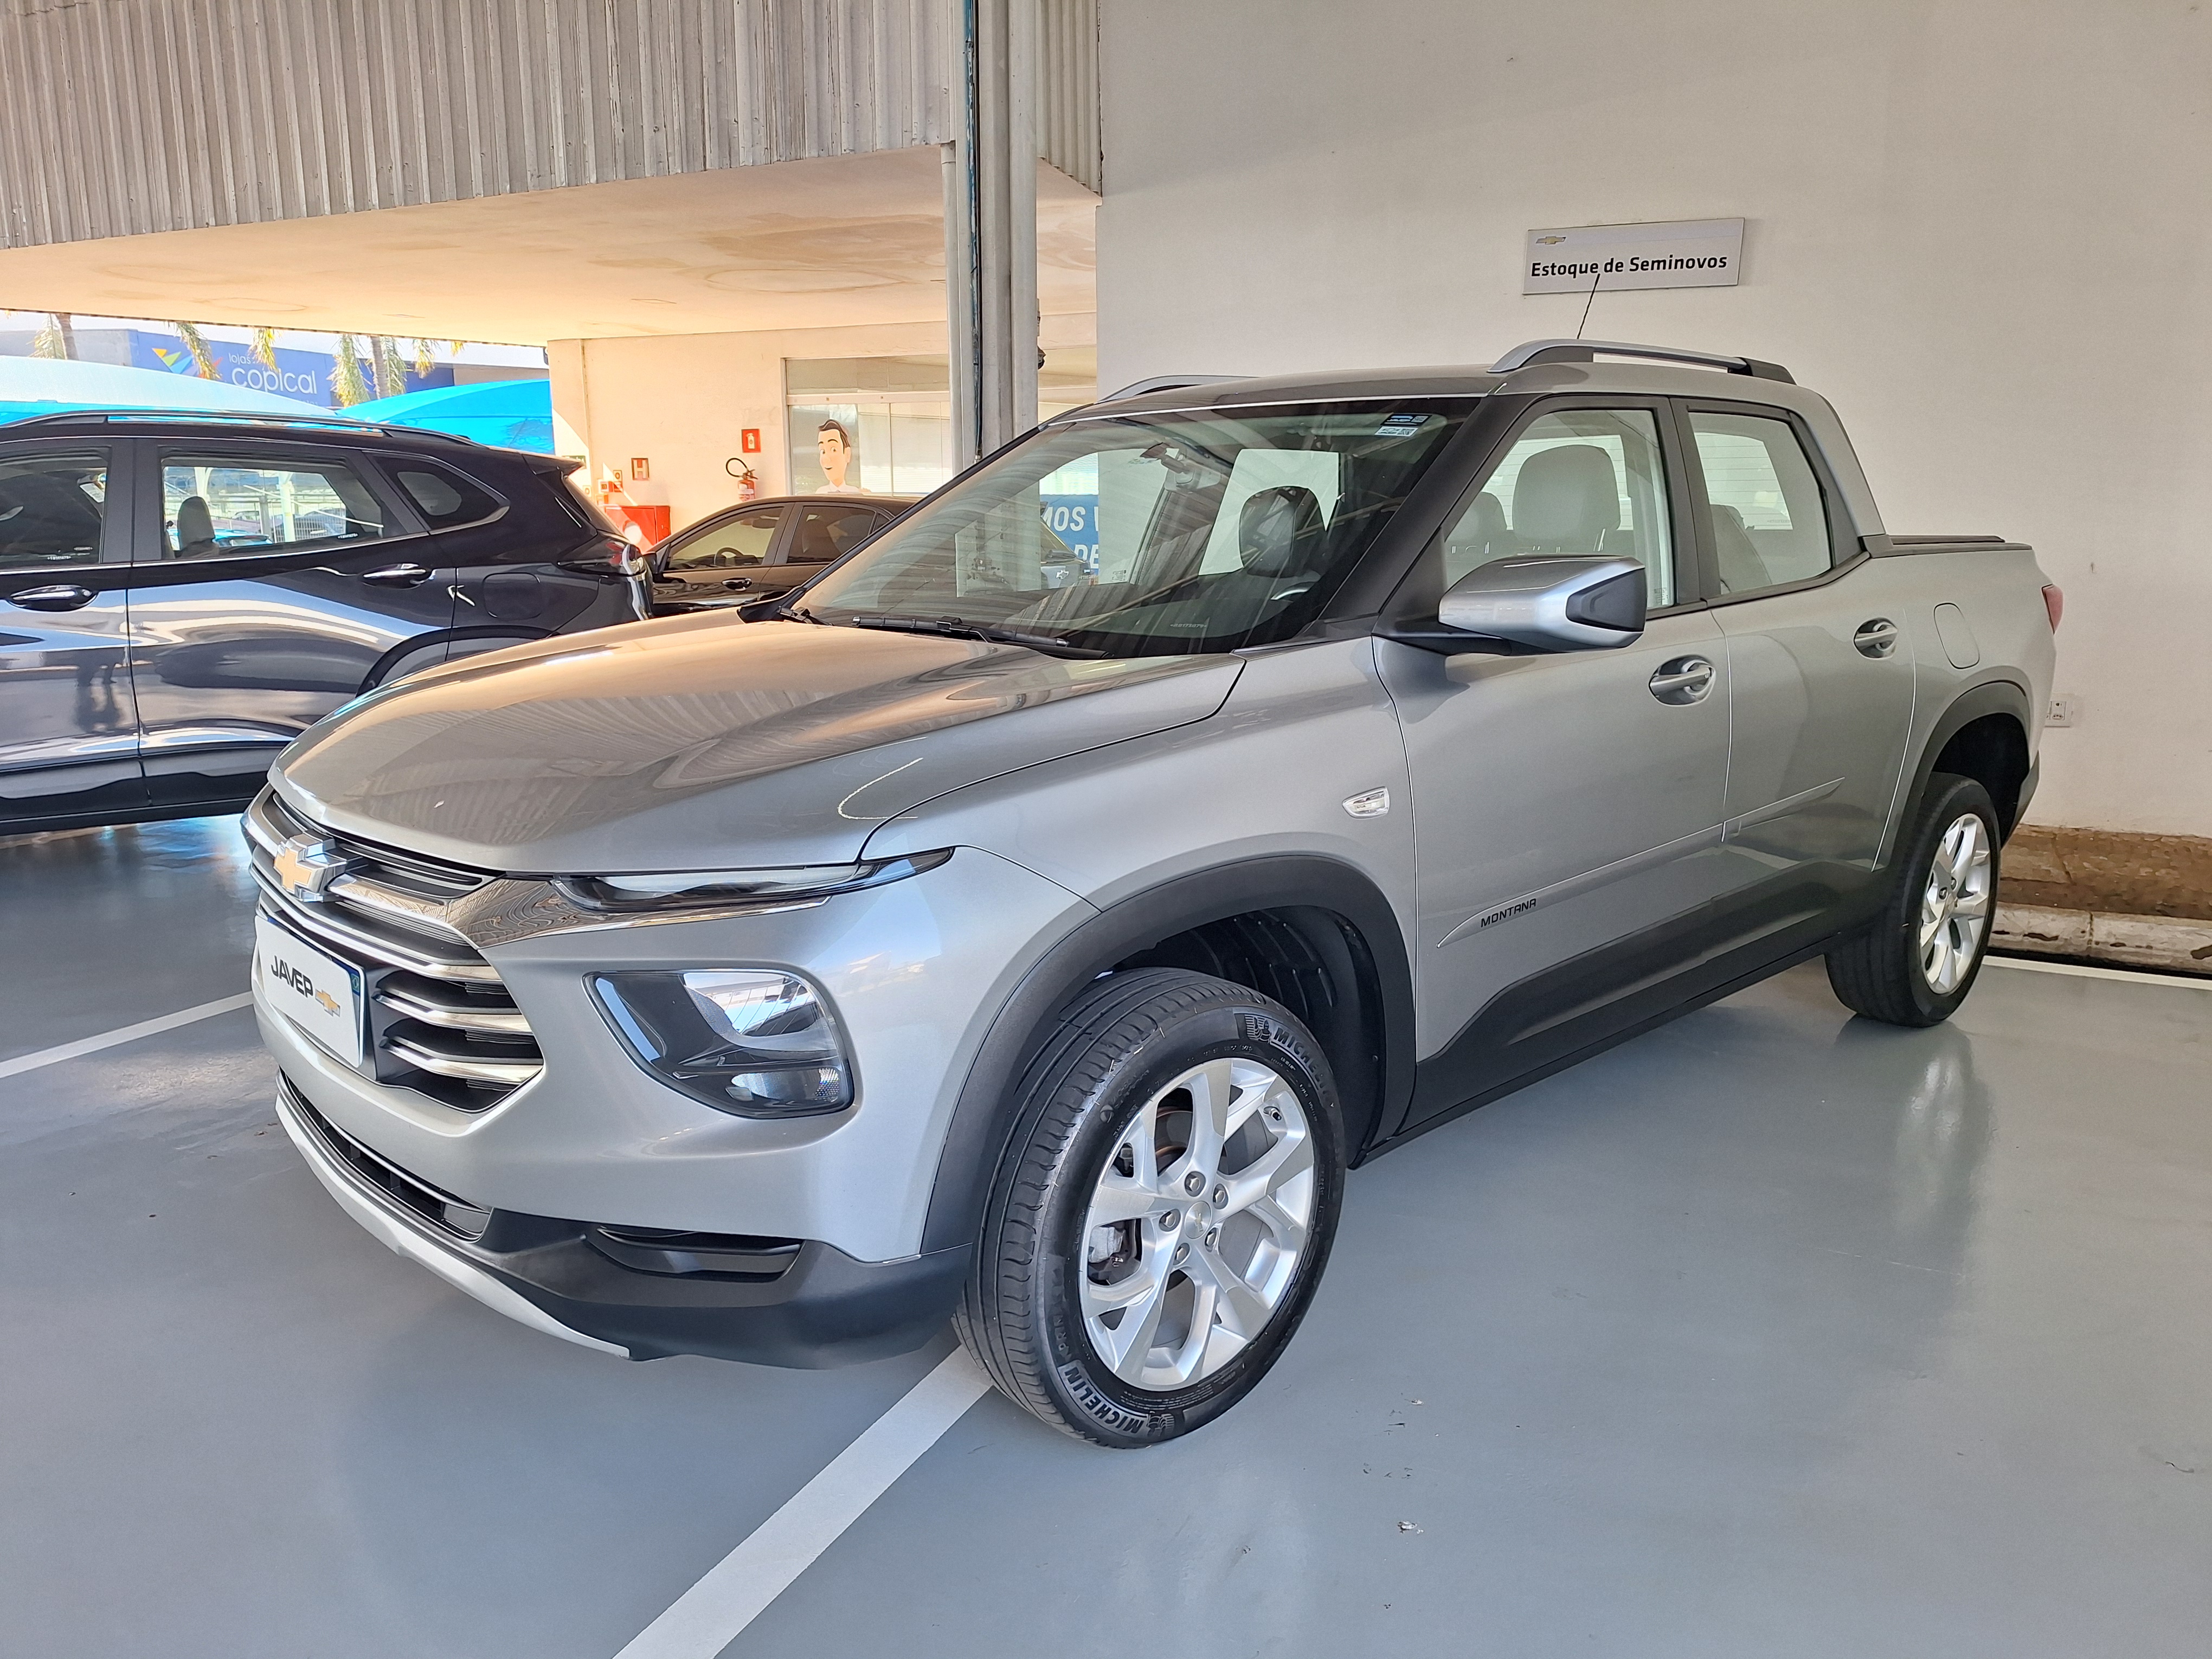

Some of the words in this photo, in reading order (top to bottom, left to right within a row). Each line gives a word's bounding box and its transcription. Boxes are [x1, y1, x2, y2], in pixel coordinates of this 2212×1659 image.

[1531, 262, 1599, 279] Estoque
[1603, 258, 1624, 273] de
[1629, 254, 1728, 272] Seminovos
[228, 353, 251, 365] lojas
[232, 367, 318, 393] copical
[633, 459, 647, 479] H
[1481, 897, 1536, 928] MONTANA
[271, 955, 313, 998] JAVEP
[1064, 1366, 1144, 1434] MICHELIN
